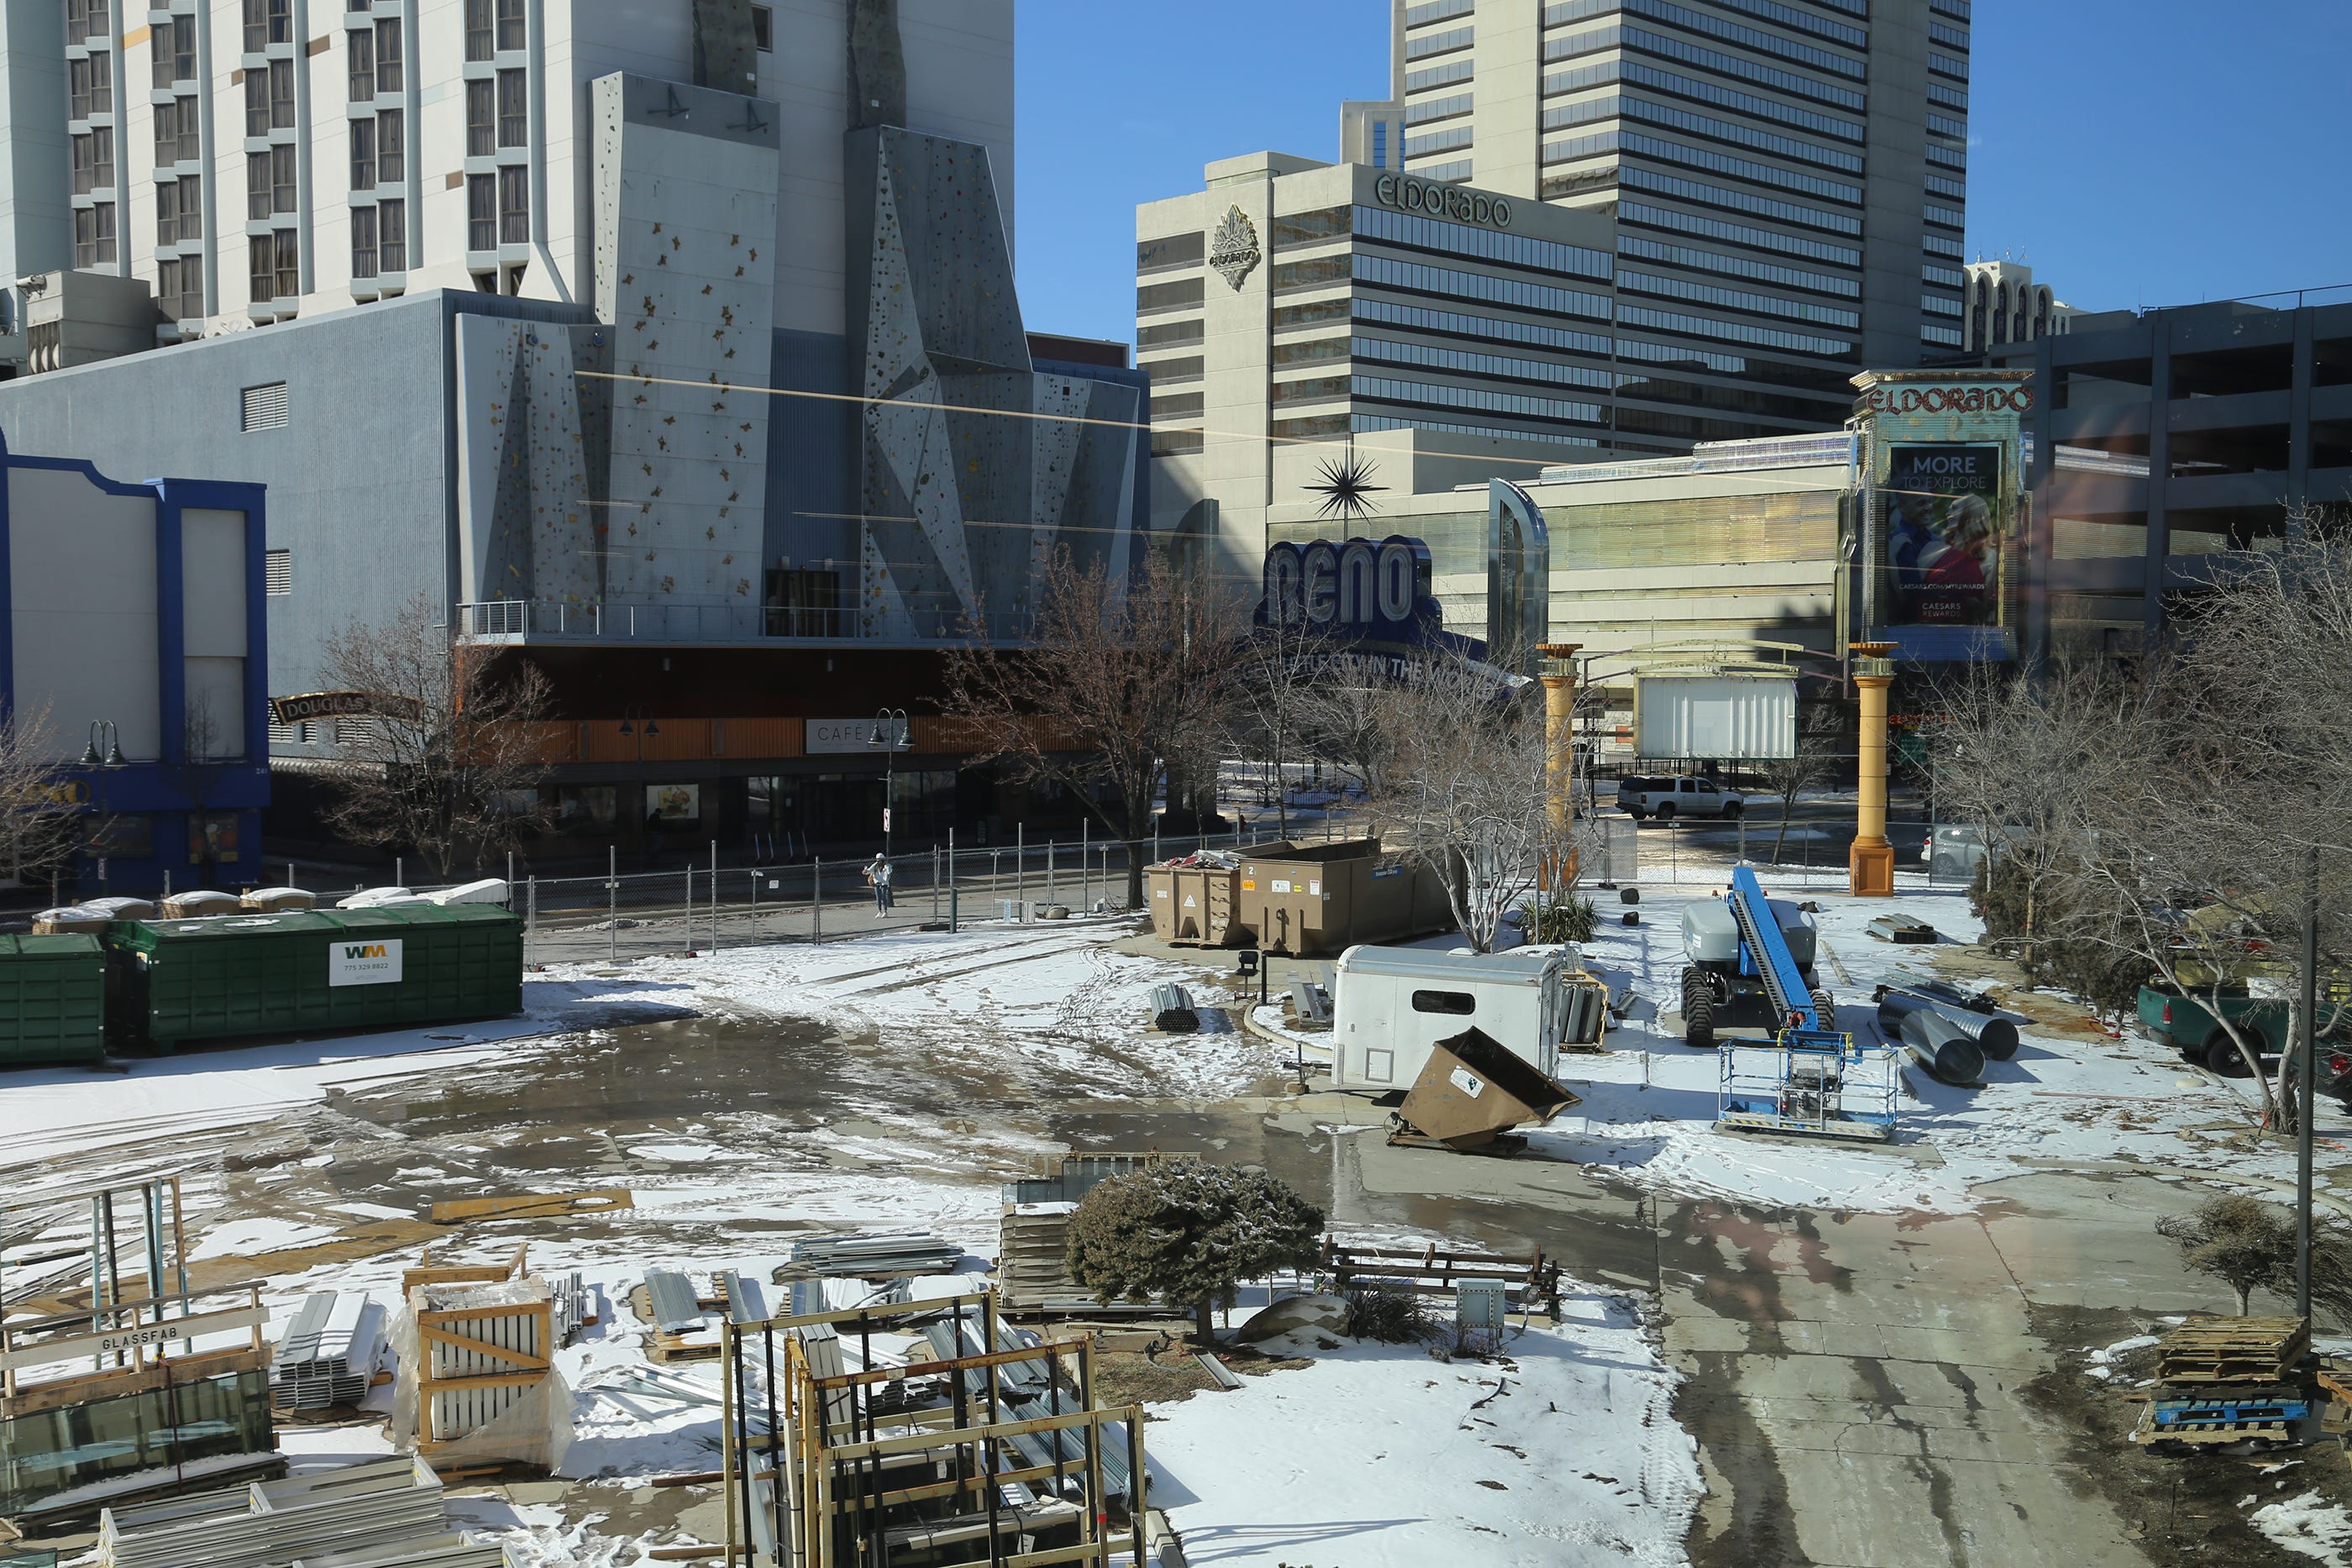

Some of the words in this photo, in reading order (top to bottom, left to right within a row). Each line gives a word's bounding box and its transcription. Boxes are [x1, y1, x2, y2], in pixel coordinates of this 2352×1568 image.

[1376, 173, 1512, 228] ELDORADO
[1866, 386, 2035, 415] ELDORADO
[1913, 456, 1977, 474] MORE
[1903, 476, 1922, 489] TO
[1925, 476, 1987, 489] EXPLORE
[1267, 543, 1413, 624] RENO
[286, 697, 365, 717] DOUGLAS
[817, 724, 864, 741] CAFÉ
[344, 944, 387, 959] WM
[102, 1327, 177, 1350] GLASSFAB
